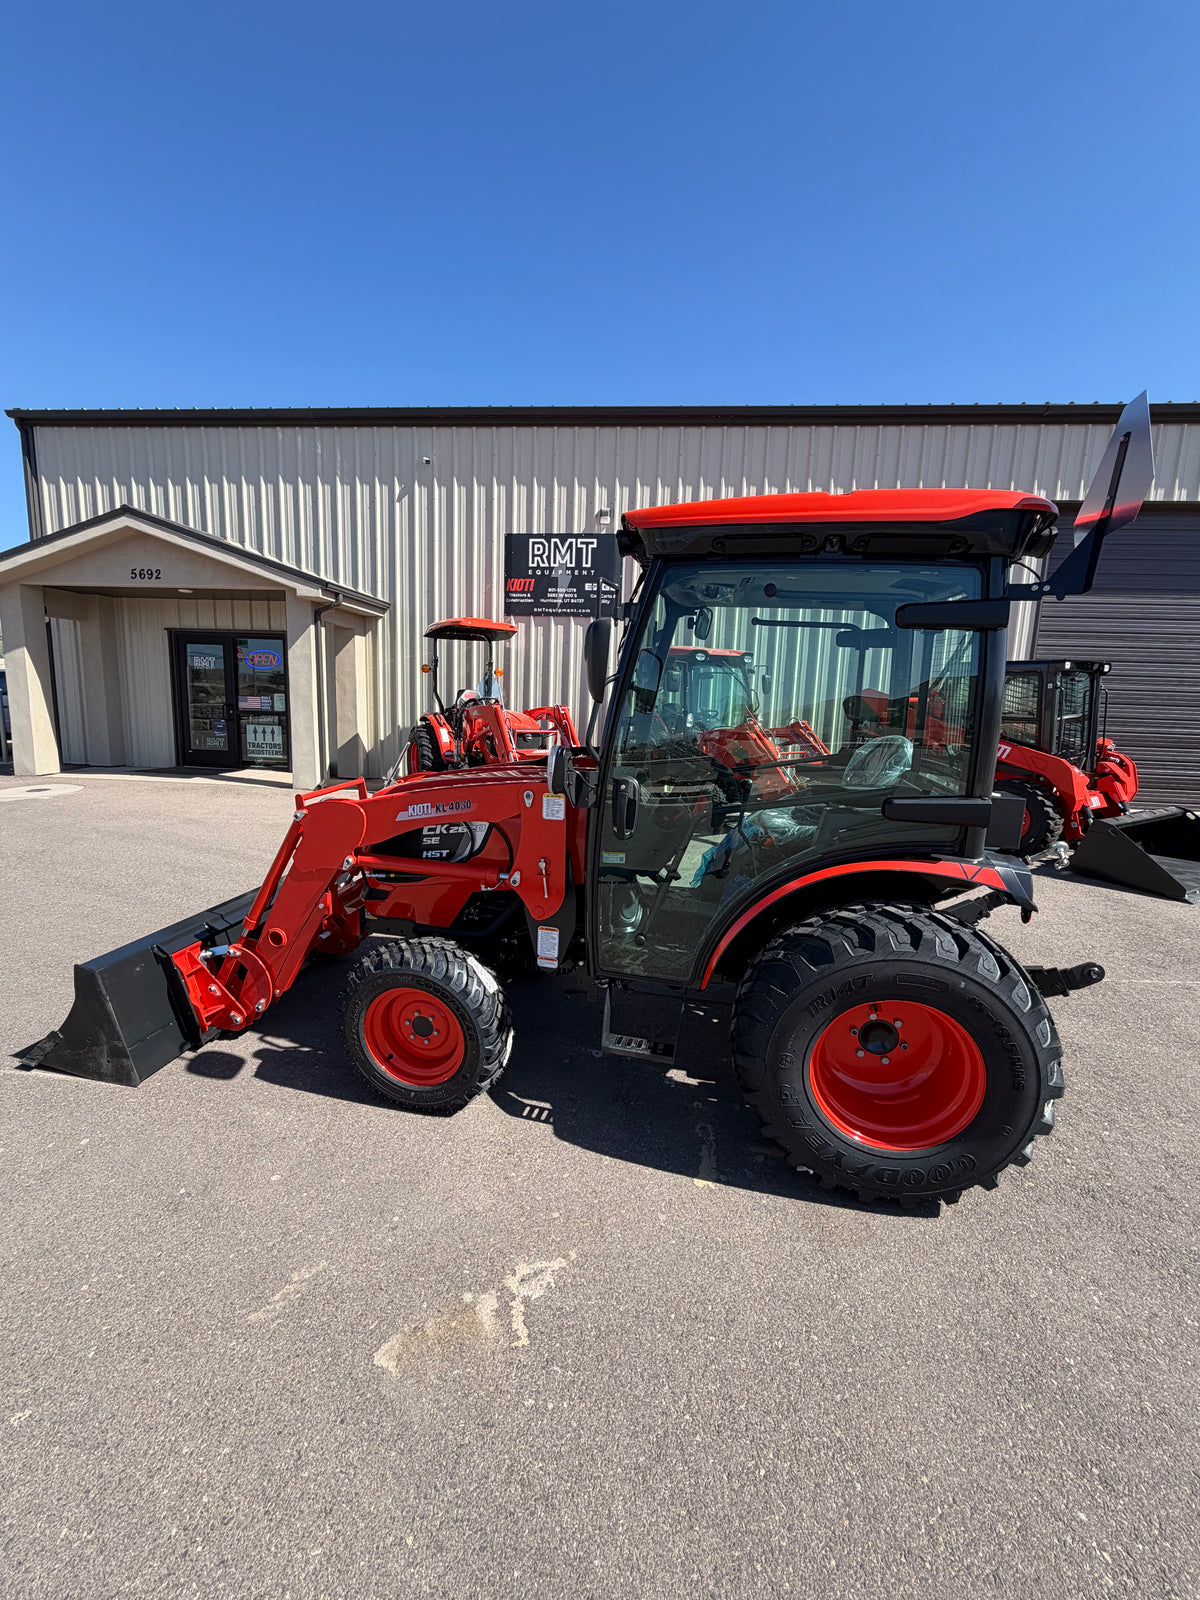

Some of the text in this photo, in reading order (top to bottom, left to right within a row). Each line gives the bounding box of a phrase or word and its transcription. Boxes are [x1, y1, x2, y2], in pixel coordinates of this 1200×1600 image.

[528, 538, 598, 568] RMT
[130, 568, 162, 580] 5692
[506, 578, 535, 592] KIOTI
[193, 656, 216, 667] RMT
[248, 654, 278, 667] OPEN
[248, 741, 282, 750] TRACTORS
[407, 800, 472, 818] KIOTI KL 4030
[422, 836, 441, 845] SE
[422, 849, 450, 859] HST
